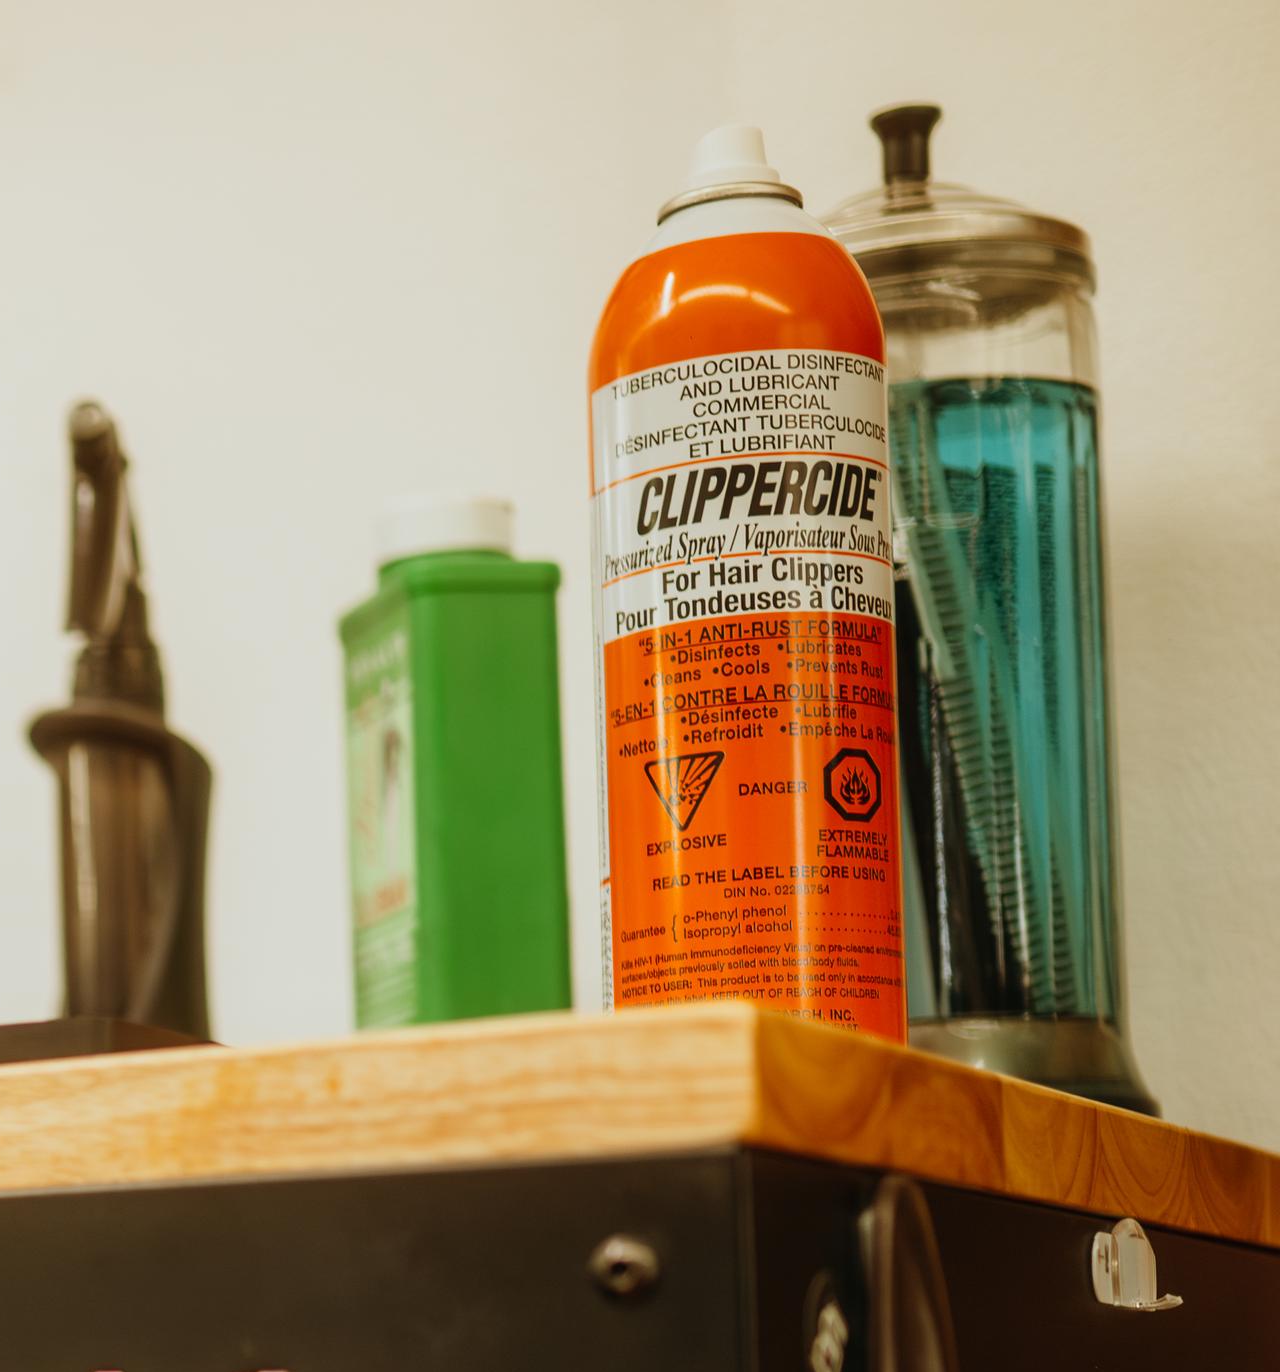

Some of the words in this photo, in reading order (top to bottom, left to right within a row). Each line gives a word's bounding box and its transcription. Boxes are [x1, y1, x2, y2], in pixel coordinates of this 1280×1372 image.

[612, 354, 781, 400] TUBERCULOCIDAL
[787, 354, 884, 384] DISINFECTANT
[680, 380, 722, 401] AND
[730, 374, 840, 392] LUBRICANT
[693, 394, 831, 418] COMMERCIAL
[615, 416, 751, 459] DÉSINFECTANT
[756, 414, 885, 443] TUBERCULOCIDE
[690, 441, 714, 458] ET
[720, 434, 836, 454] LUBRIFIANT
[636, 460, 878, 536] CLIPPERCIDE
[605, 535, 673, 581] Pressurized
[677, 531, 726, 565] Spray
[744, 521, 846, 556] Vaporisateur
[849, 524, 875, 553] Sous
[662, 570, 700, 595] For
[709, 560, 763, 587] Hair
[771, 557, 864, 587] Clippers
[616, 606, 658, 635] Pour
[664, 590, 801, 621] Tondeuses
[809, 584, 823, 609] à
[699, 620, 802, 643] ANTI-RUST
[861, 661, 884, 680] Rust
[662, 687, 737, 711] CONTRE
[743, 685, 768, 701] LA
[773, 684, 849, 700] ROUILLE
[852, 685, 894, 709] FORMU
[860, 724, 874, 740] La
[738, 781, 808, 796] DANGER
[646, 833, 727, 857] EXPLOSIVE
[818, 829, 888, 846] EXTREMELY
[817, 845, 889, 862] FLAMMABLE
[652, 874, 691, 891] READ
[695, 870, 727, 884] THE
[731, 866, 784, 881] LABEL
[789, 866, 849, 879] BEFORE
[853, 866, 886, 882] USING
[723, 887, 746, 899] DIN
[750, 886, 771, 897] No.
[683, 907, 738, 924] o-Phenyl
[742, 904, 787, 920] phenol
[621, 925, 666, 943] Guarantee
[683, 923, 741, 940] Isopropyl
[745, 920, 793, 934] alcohol
[815, 943, 826, 952] on
[679, 961, 725, 977] previously
[727, 959, 756, 970] soiled
[759, 957, 780, 968] with
[622, 985, 648, 1000] NOTICE
[650, 983, 662, 994] TO
[663, 979, 693, 992] USER:
[697, 977, 718, 988] This
[721, 973, 760, 986] product
[763, 973, 771, 983] is
[774, 974, 784, 983] to
[787, 972, 799, 982] be
[828, 972, 847, 984] only
[742, 988, 766, 999] OUT
[768, 988, 783, 999] OF
[786, 987, 822, 998] REACH
[824, 987, 837, 998] OF
[830, 1009, 855, 1022] INC.
